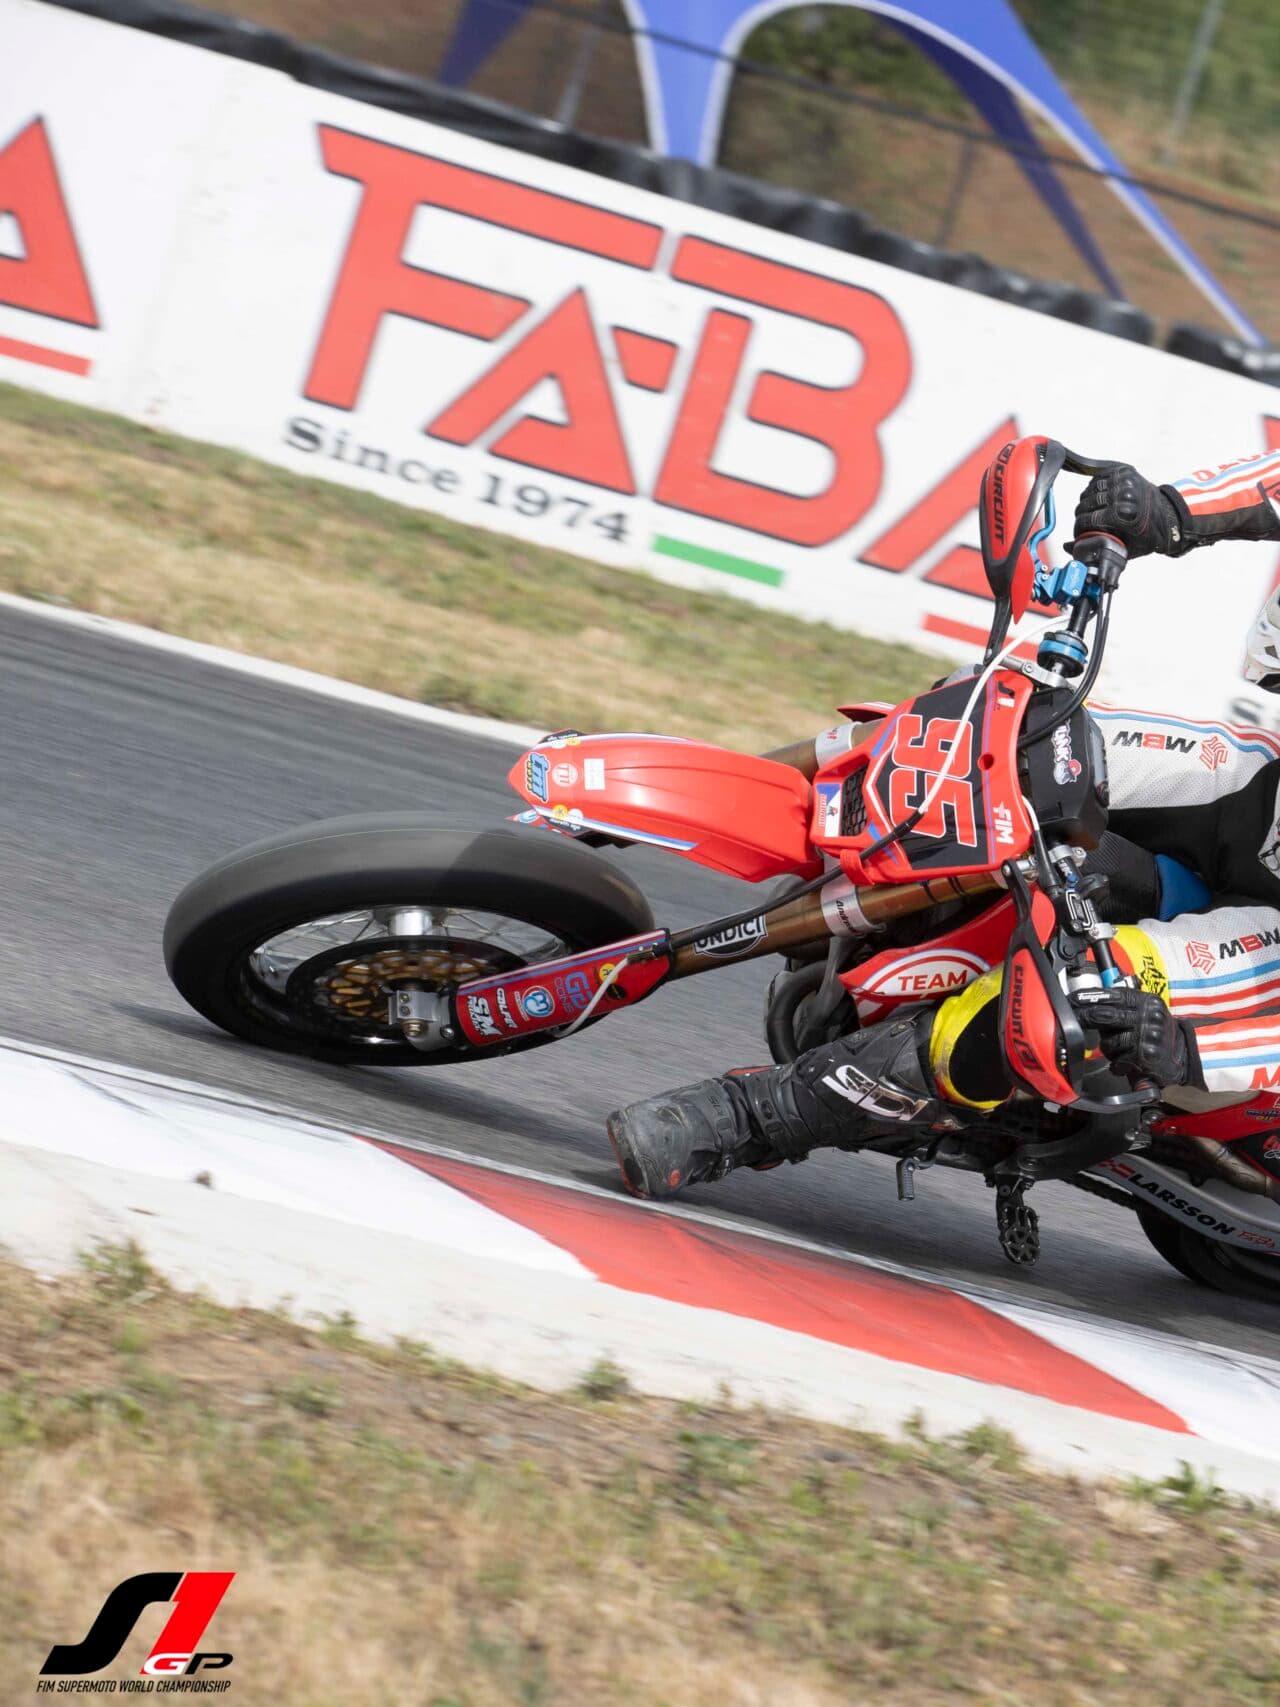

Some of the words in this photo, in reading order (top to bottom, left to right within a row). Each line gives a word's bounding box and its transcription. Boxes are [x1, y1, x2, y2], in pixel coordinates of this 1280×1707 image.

[284, 414, 462, 495] Since
[485, 473, 631, 543] 1974
[1111, 730, 1197, 754] MBW
[889, 712, 978, 849] 95
[992, 800, 1015, 845] FIM
[897, 970, 968, 992] TEAM
[1129, 1169, 1237, 1236] LARSSON
